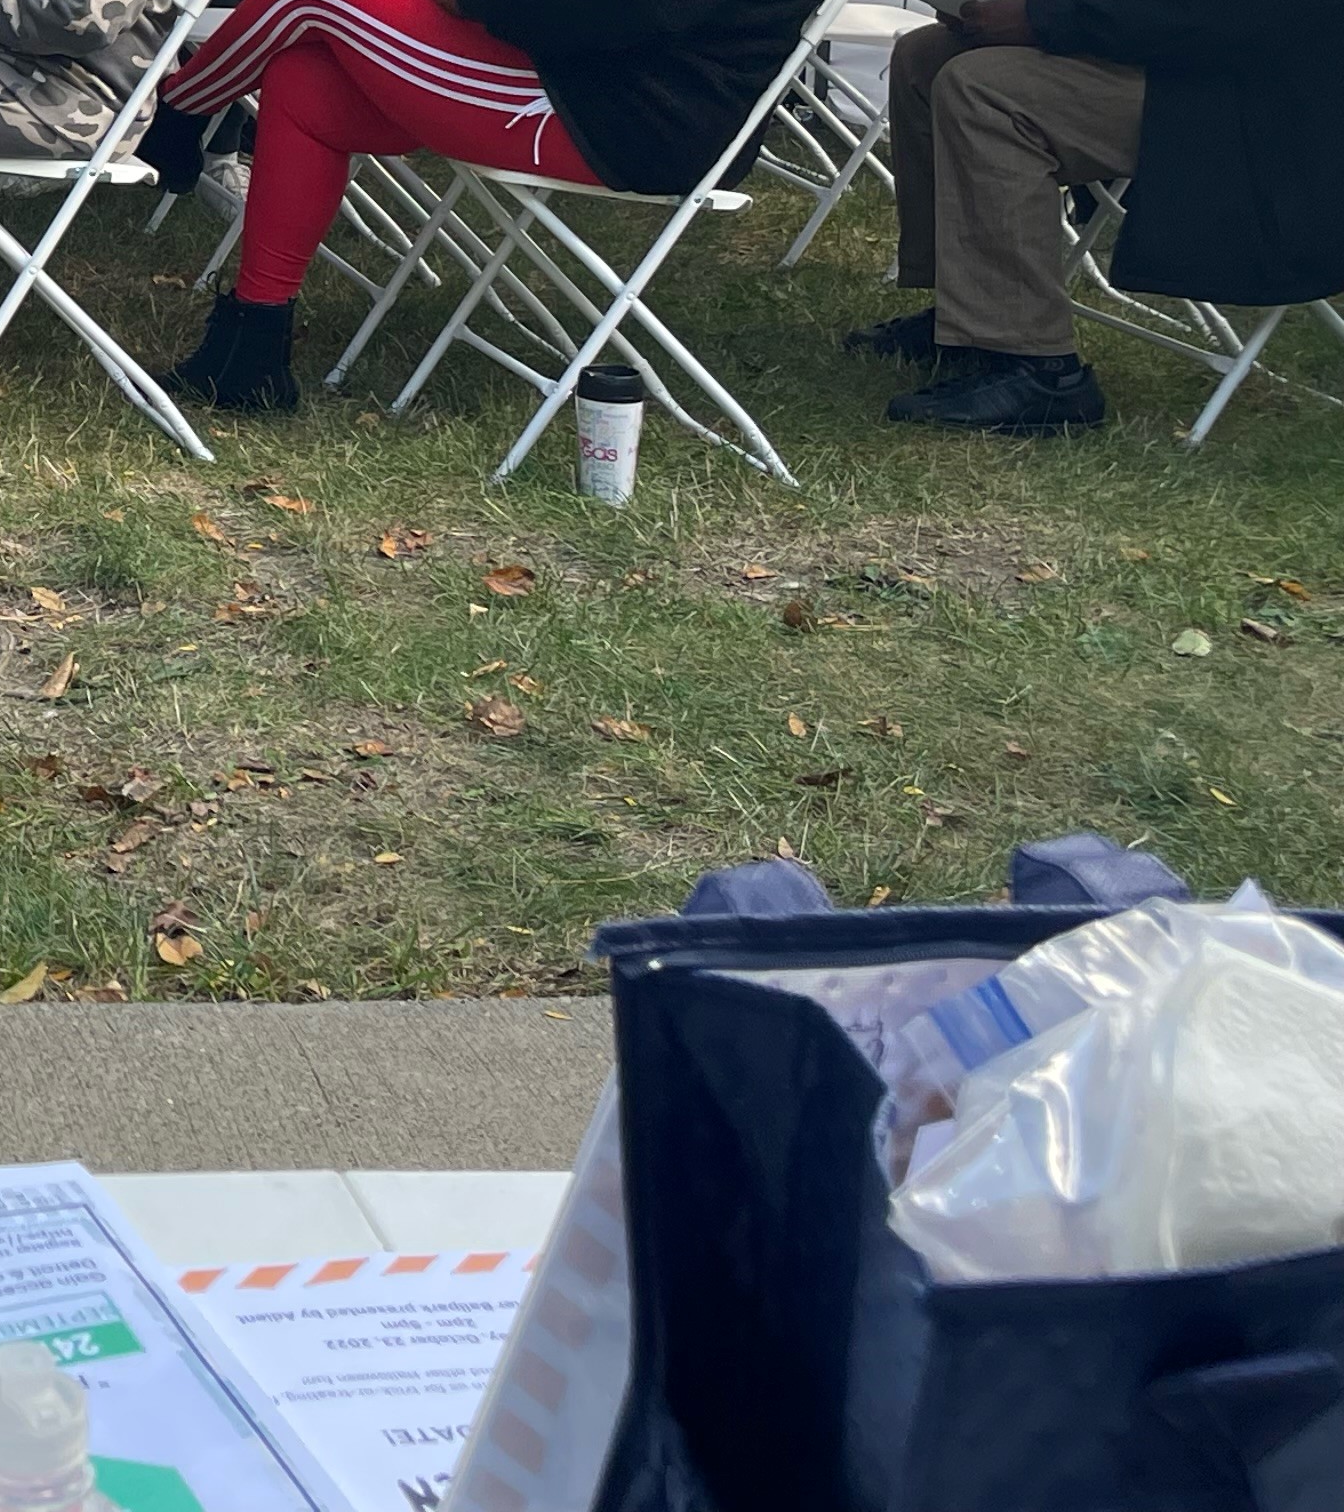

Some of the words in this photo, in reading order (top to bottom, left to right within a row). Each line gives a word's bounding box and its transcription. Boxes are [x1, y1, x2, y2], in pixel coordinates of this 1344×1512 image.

[56, 1272, 107, 1287] Gain
[325, 1302, 417, 1319] presented
[422, 1301, 494, 1314] Ballpark
[301, 1308, 324, 1321] by
[436, 1318, 477, 1329] 2pm
[324, 1338, 373, 1350] 2022
[410, 1332, 481, 1345] October
